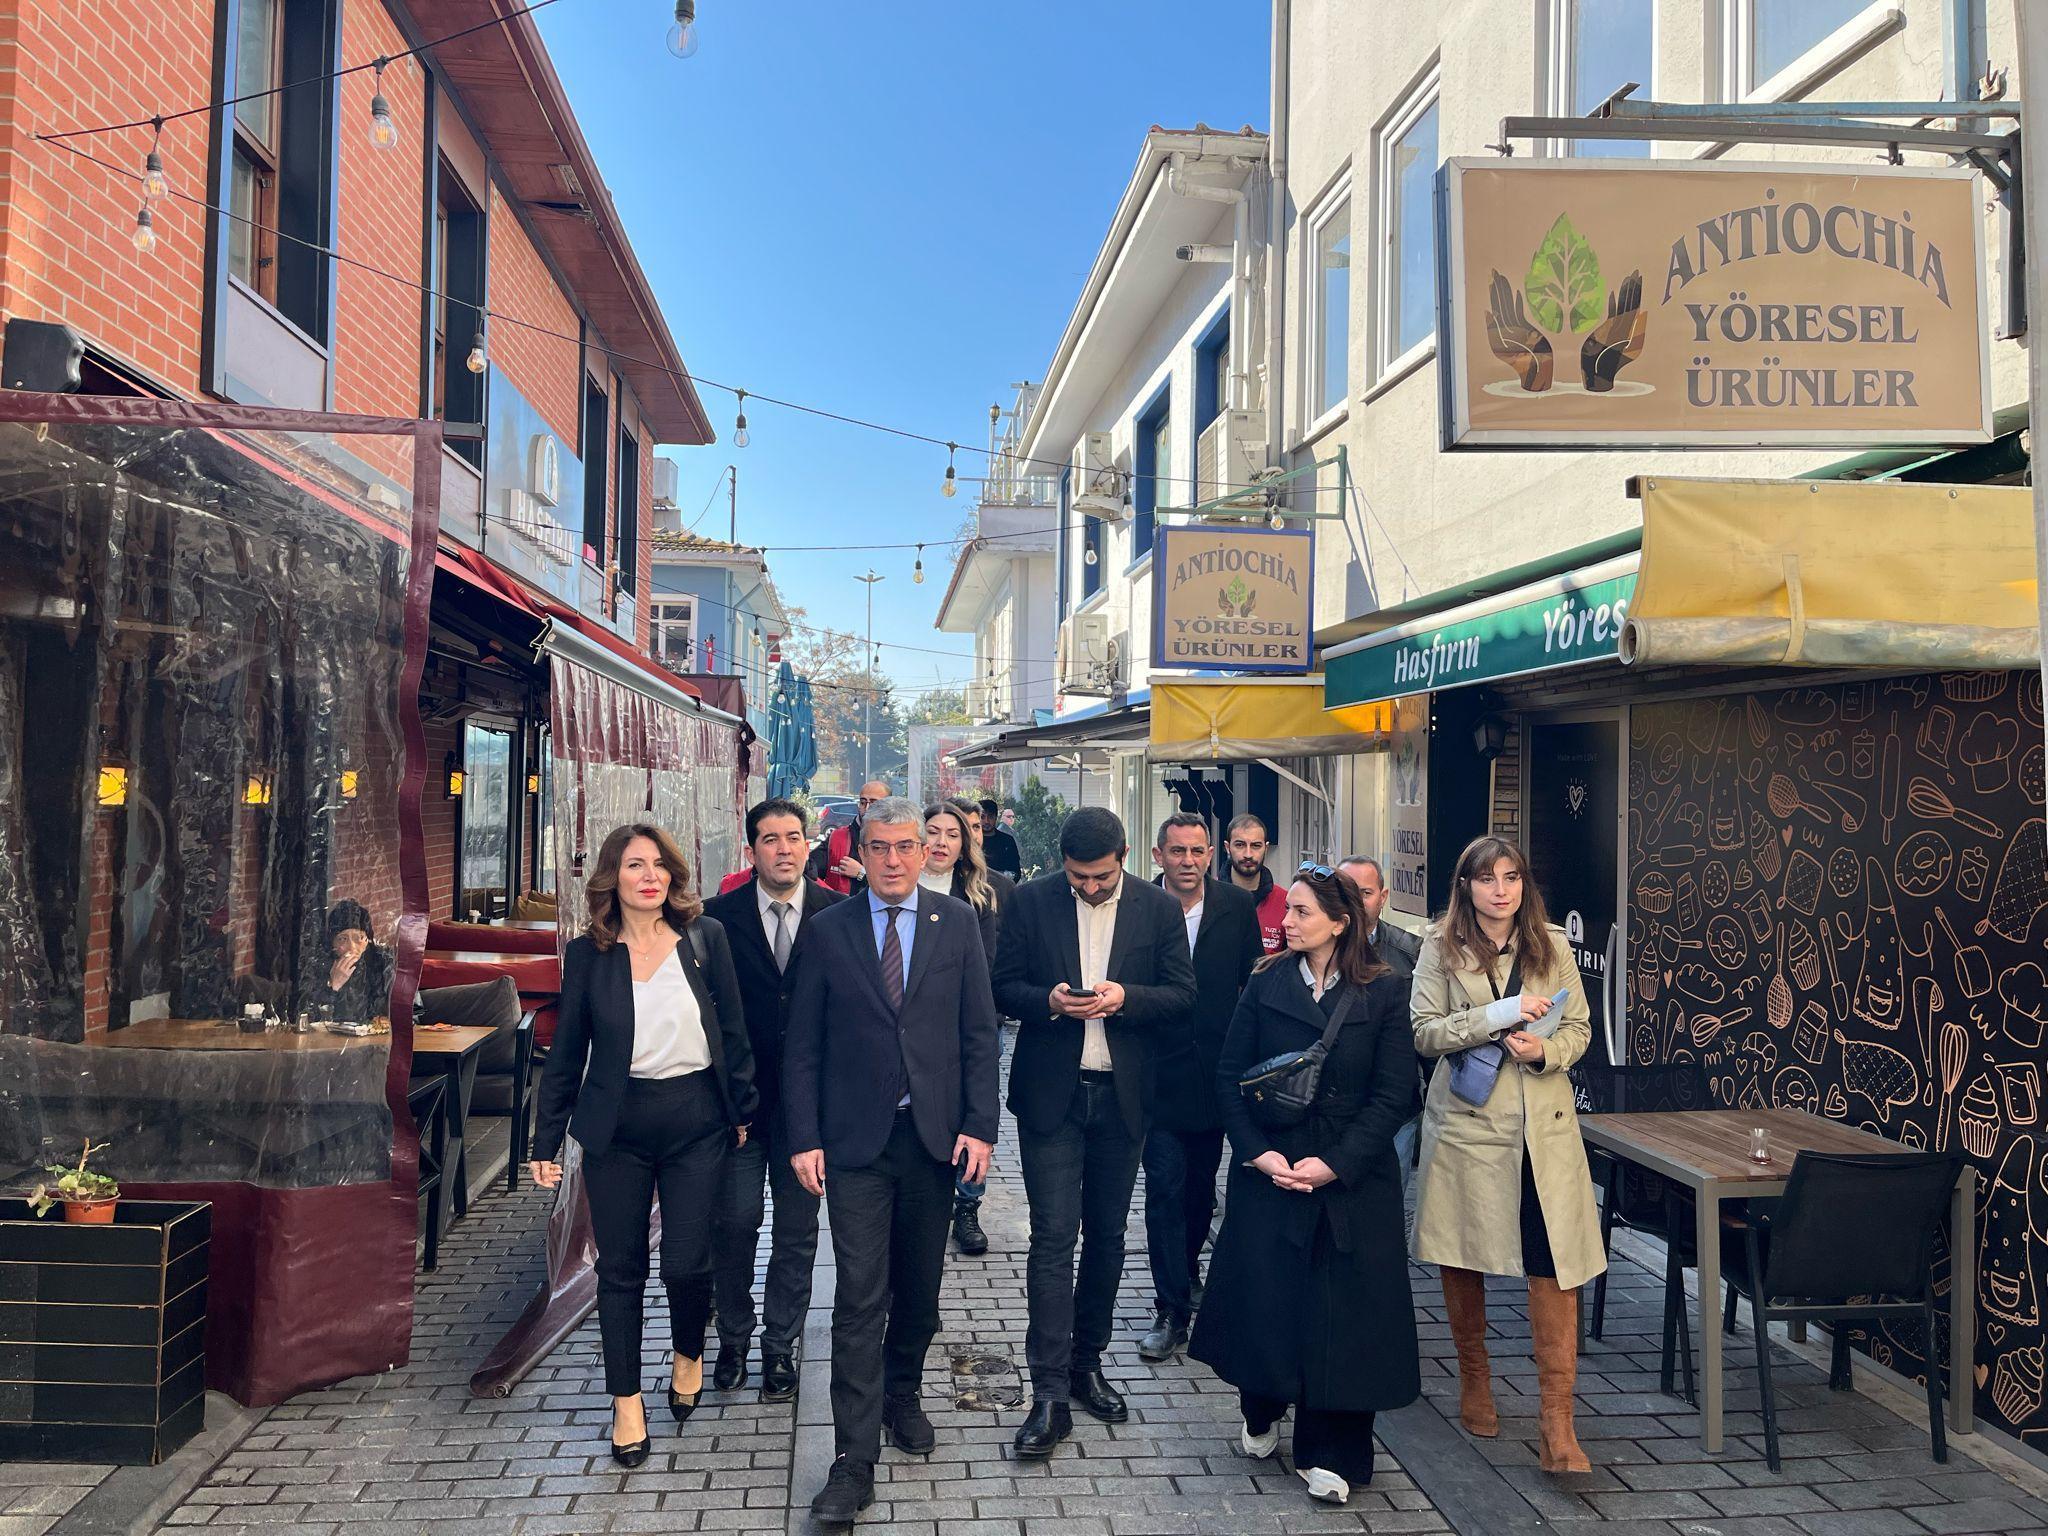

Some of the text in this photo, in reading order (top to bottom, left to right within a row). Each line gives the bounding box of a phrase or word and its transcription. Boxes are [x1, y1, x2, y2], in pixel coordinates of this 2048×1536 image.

[1660, 187, 1953, 310] ANTİOCHİA
[1685, 291, 1920, 344] YÖRESEL
[1685, 357, 1920, 408] ÜRÜNLER
[1172, 542, 1298, 595] ANTİOCHİA
[1173, 637, 1299, 659] ÜRÜNLER
[1174, 616, 1301, 637] YÖRESEL
[1393, 632, 1481, 688] Hasfırın
